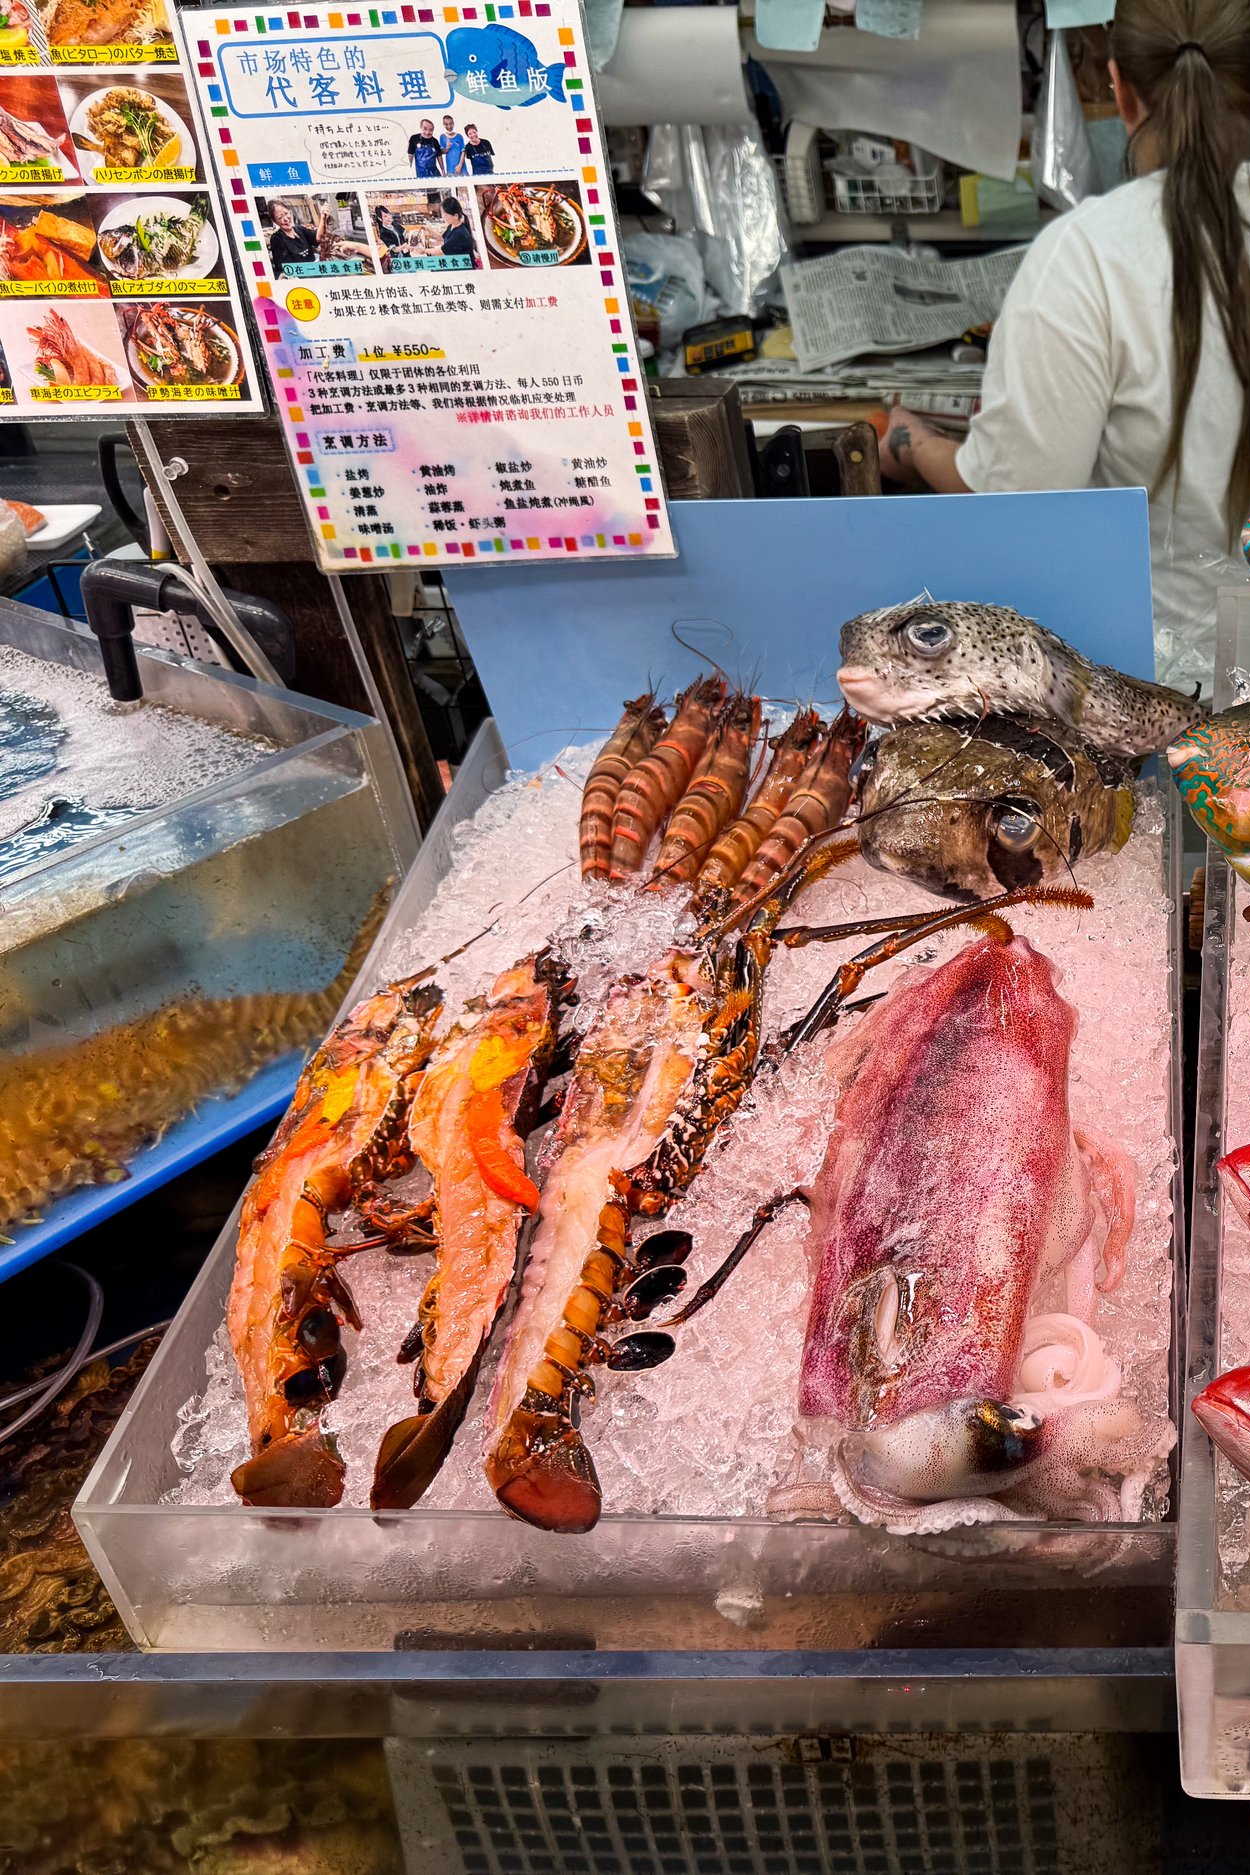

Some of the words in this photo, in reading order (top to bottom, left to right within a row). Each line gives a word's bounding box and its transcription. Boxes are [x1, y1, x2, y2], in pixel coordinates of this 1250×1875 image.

[236, 46, 366, 75] 市场特色的
[465, 67, 552, 95] 鲜鱼版
[265, 69, 431, 108] 代客料理
[95, 167, 195, 180] ハリセンボンの唐揚げ
[292, 299, 314, 311] 注意
[299, 345, 346, 360] 加工费
[30, 386, 121, 399] 車海老のエビフライ
[148, 386, 240, 399] 伊勢海老の味噌汁
[324, 434, 387, 450] 烹调方法
[571, 457, 607, 471] 黄油炒
[575, 476, 612, 489] 糖醋鱼
